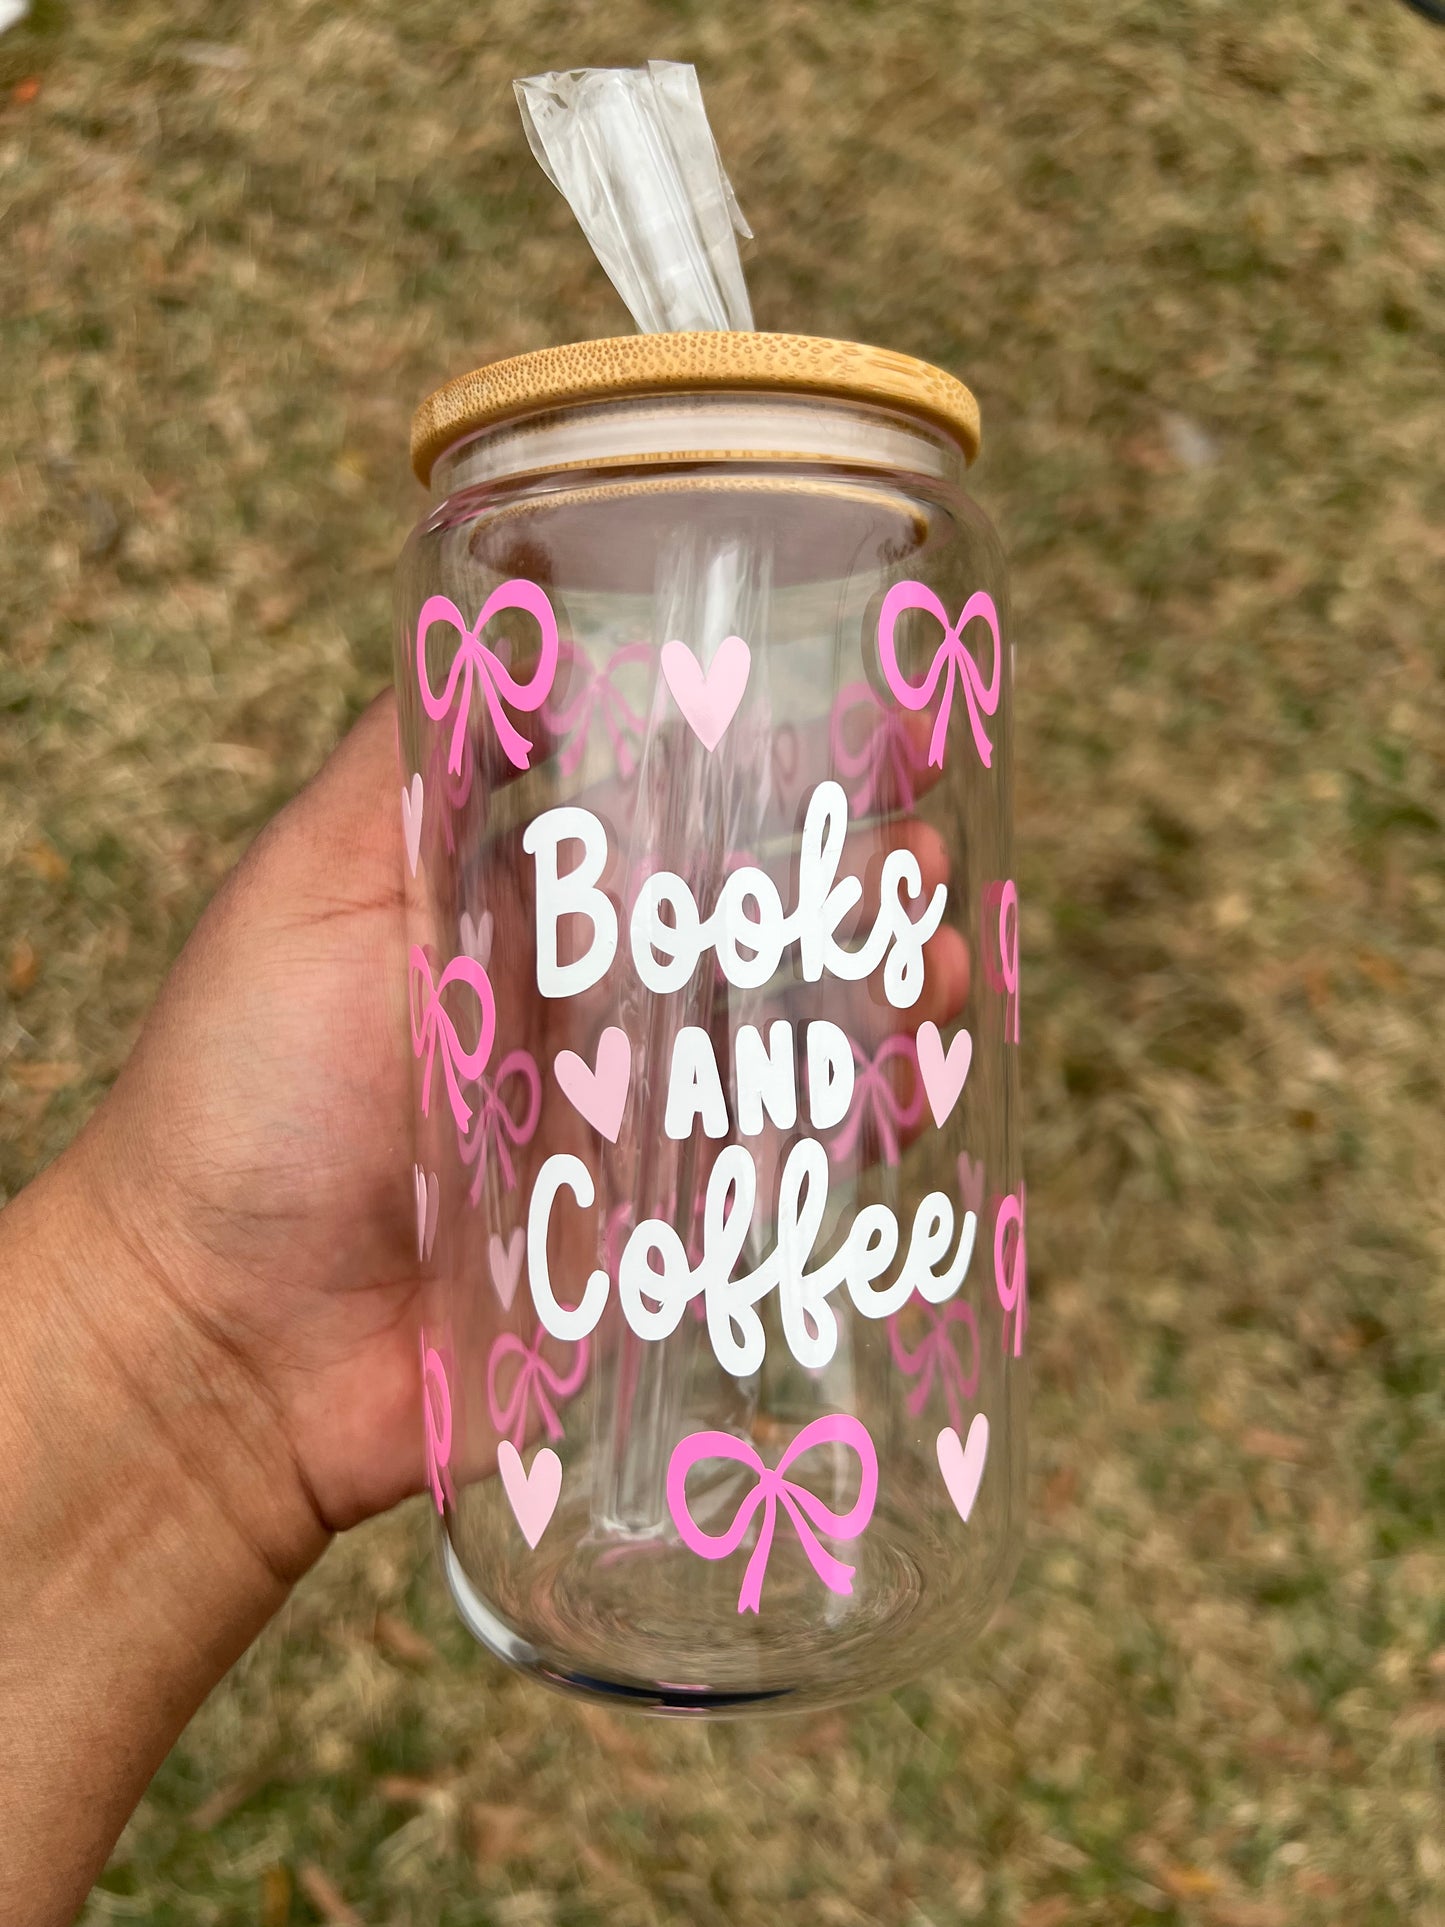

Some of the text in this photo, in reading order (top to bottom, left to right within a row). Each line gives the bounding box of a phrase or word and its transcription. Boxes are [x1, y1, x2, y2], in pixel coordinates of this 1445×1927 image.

[522, 780, 948, 1009] Books
[664, 1020, 855, 1140] AND
[527, 1137, 977, 1377] Coffee
